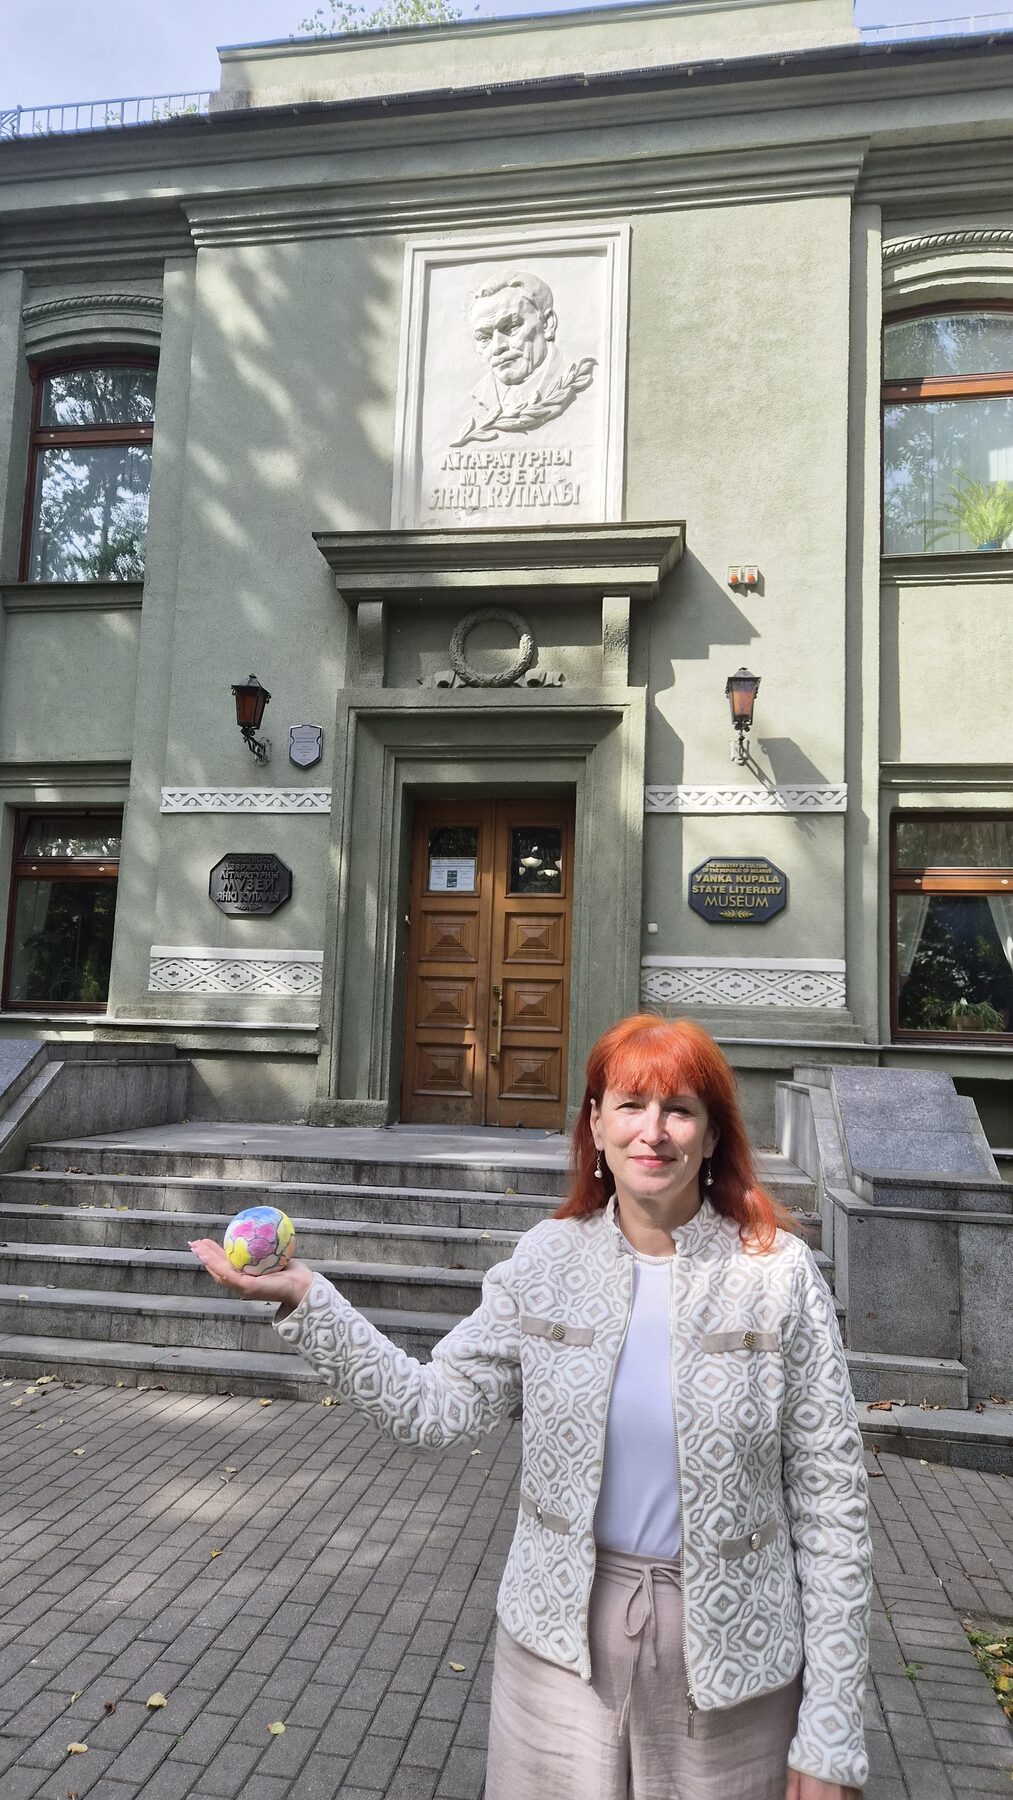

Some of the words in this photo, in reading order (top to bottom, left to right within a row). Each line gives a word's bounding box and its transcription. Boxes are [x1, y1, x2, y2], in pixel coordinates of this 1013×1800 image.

[440, 449, 572, 470] ЛІТАРАТУРНЫ
[461, 467, 545, 487] МУЗЕЙ
[428, 485, 482, 510] ЯНКІ
[487, 482, 580, 509] КУПАЛЫ
[695, 874, 733, 883] YANKA
[735, 875, 780, 884] KUPALA
[692, 885, 727, 894] STATE
[729, 886, 783, 895] LITERARY
[704, 895, 769, 908] MUSEUM
